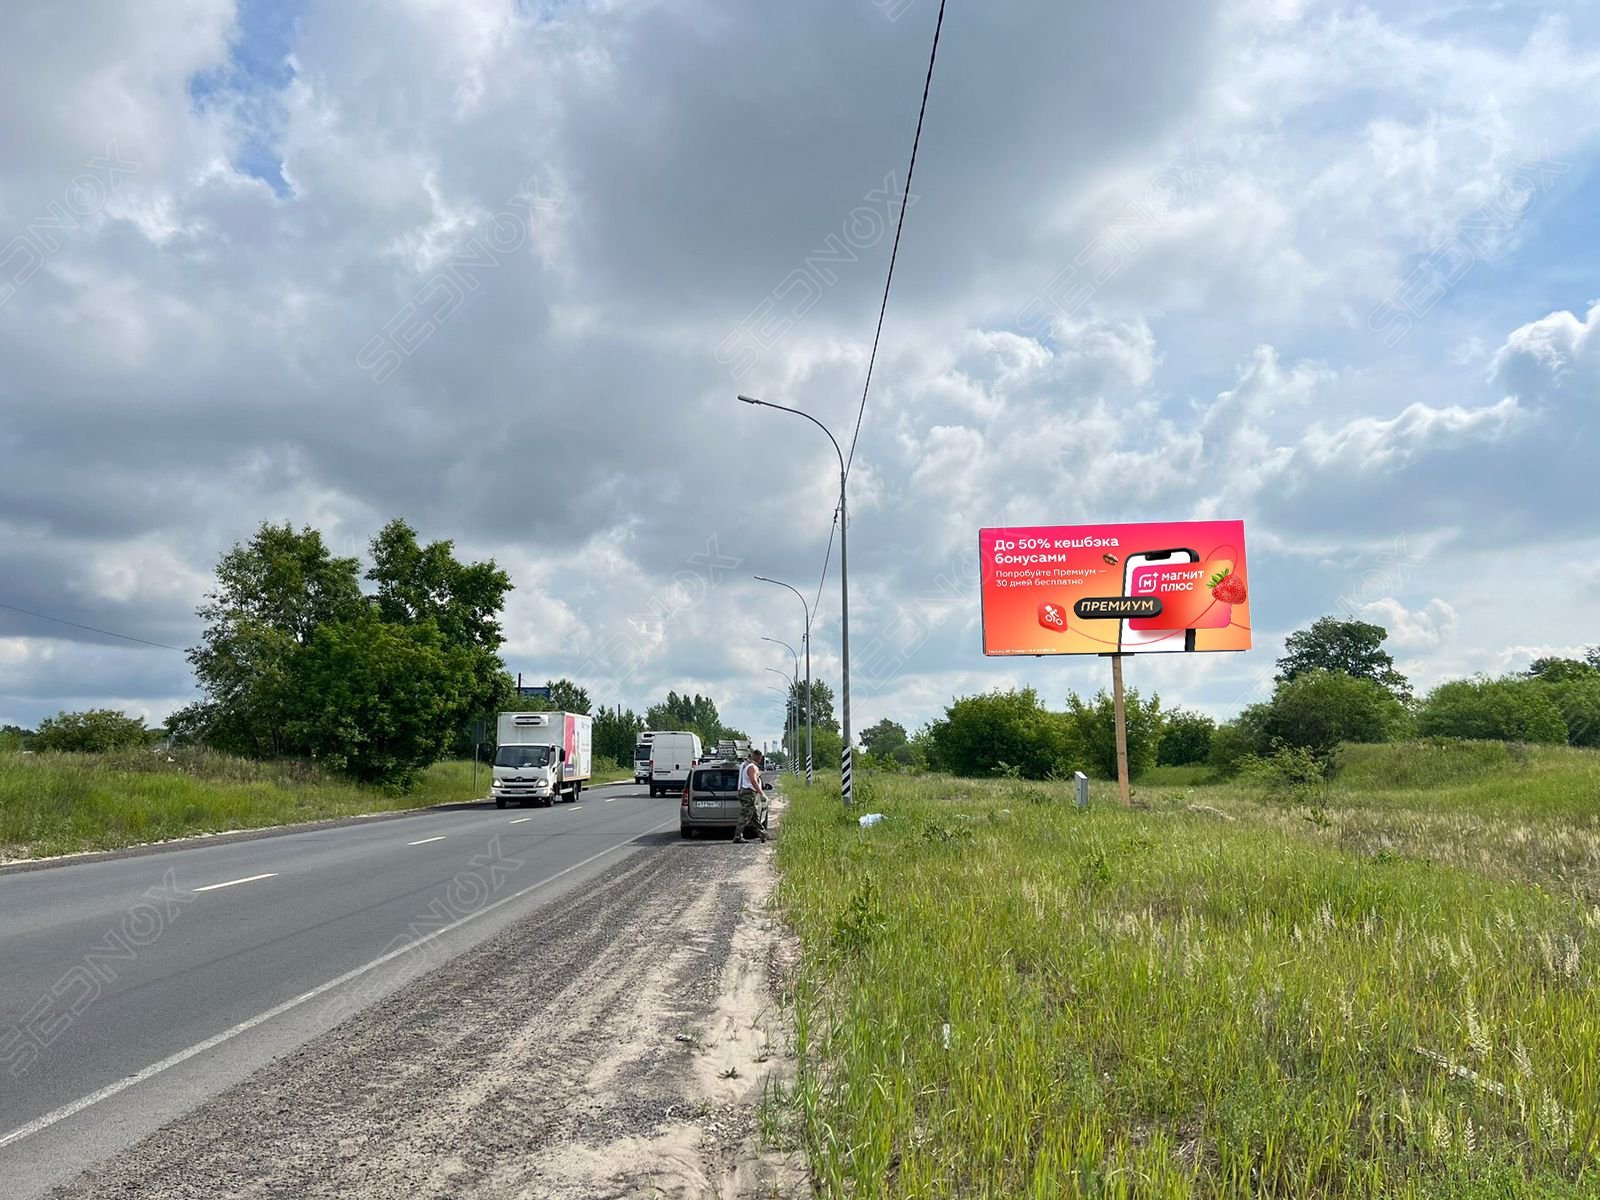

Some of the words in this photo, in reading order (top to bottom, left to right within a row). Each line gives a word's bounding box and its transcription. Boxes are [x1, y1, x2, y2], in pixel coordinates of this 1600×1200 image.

[994, 539, 1015, 551] До
[1018, 538, 1051, 549] 50%
[1054, 536, 1119, 549] кешбэка
[994, 553, 1066, 566] бонусами
[995, 569, 1051, 578] Попробуйте
[1053, 568, 1096, 577] Премиум
[996, 579, 1008, 587] 30
[1009, 579, 1032, 588] дней
[1034, 578, 1083, 586] бесплатно
[1080, 600, 1154, 611] ПРЕМИУМ
